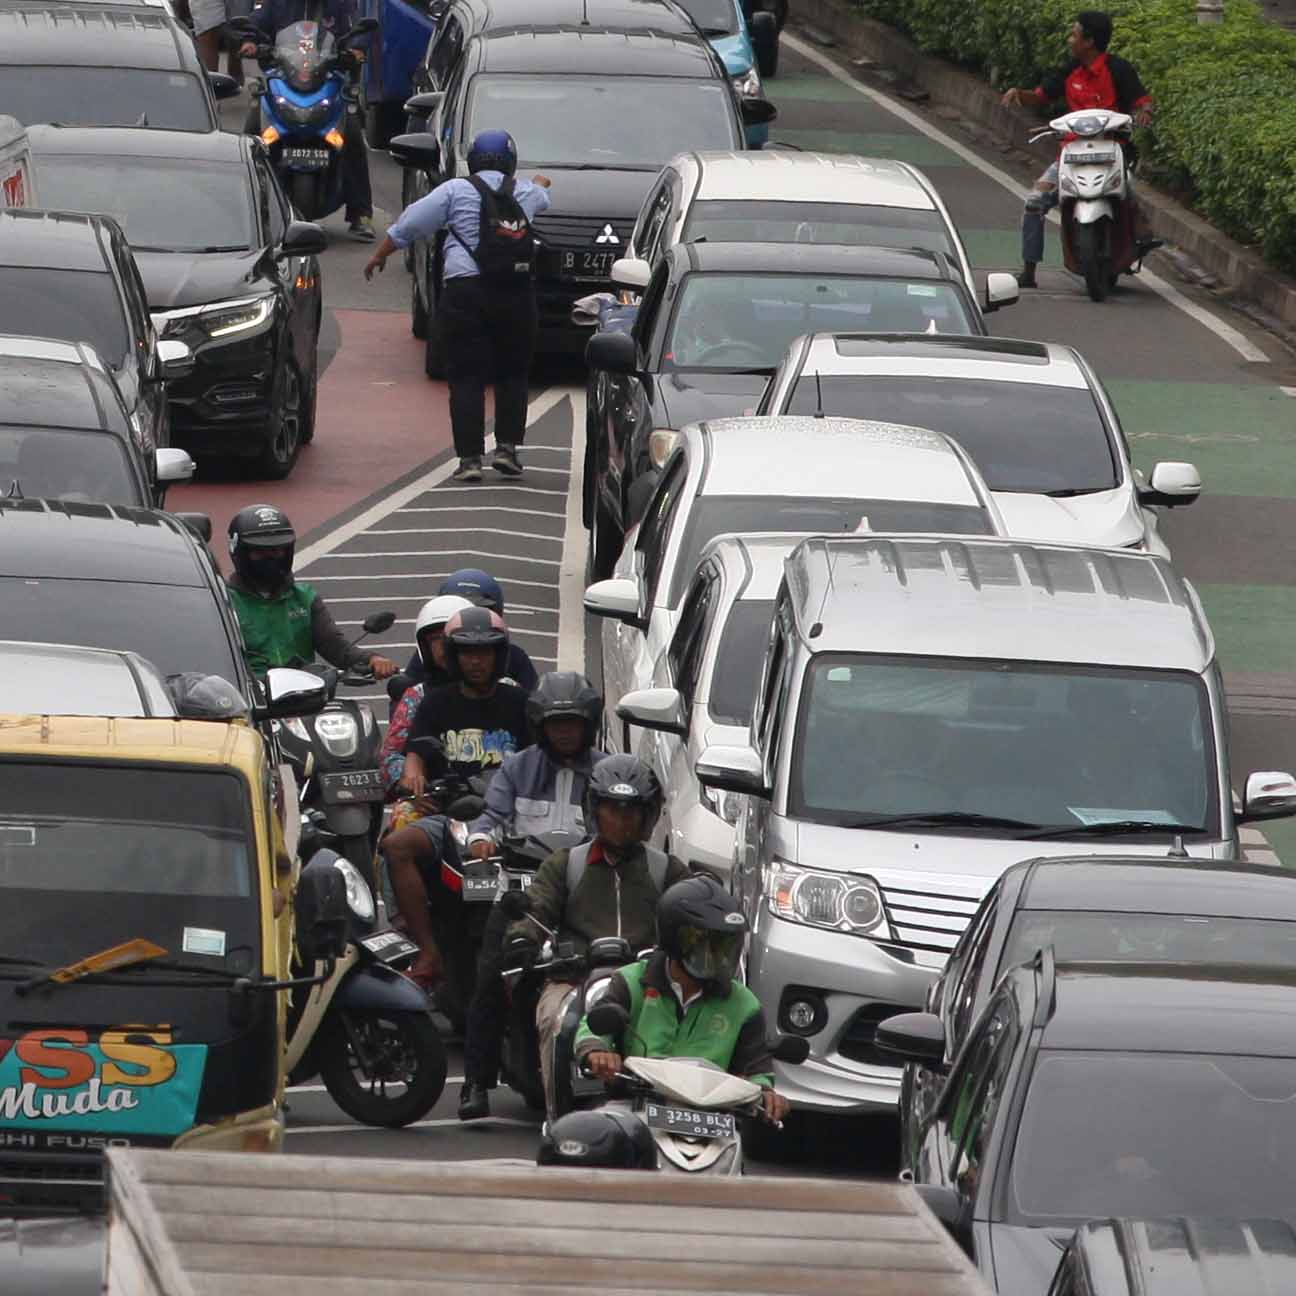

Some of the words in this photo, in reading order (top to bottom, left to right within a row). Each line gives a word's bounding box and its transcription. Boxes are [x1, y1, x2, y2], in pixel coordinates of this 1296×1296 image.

[565, 252, 575, 268] B
[649, 1106, 658, 1117] B
[667, 1110, 702, 1124] 3258
[706, 1115, 732, 1129] BLY
[48, 1135, 130, 1150] FUSO
